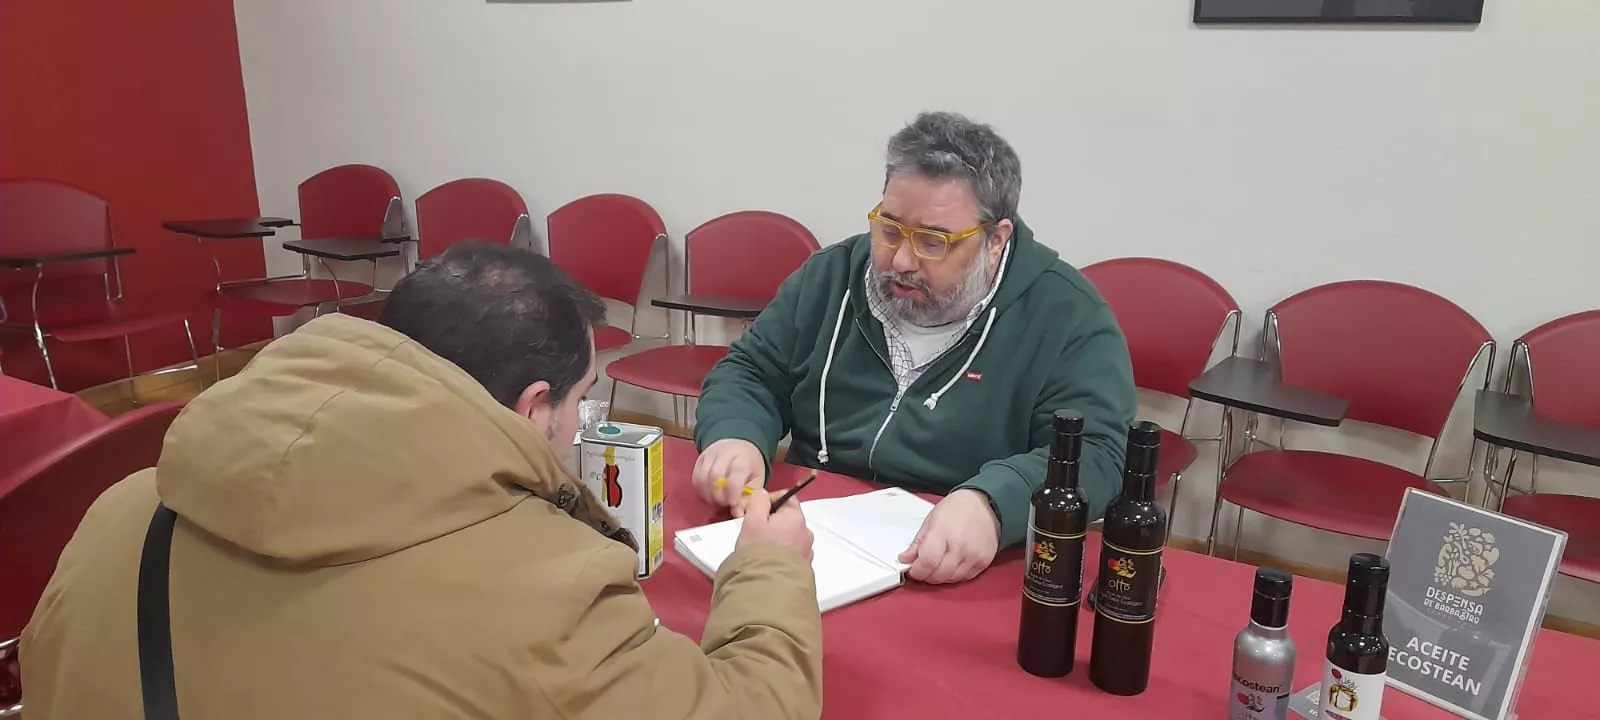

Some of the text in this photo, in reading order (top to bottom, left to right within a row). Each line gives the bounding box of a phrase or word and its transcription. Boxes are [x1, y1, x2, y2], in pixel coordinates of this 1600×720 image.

[1423, 598, 1434, 608] DE
[1434, 602, 1480, 625] BARBASTRO
[1426, 586, 1484, 616] DESPENSA
[1406, 636, 1471, 671] ACEITE
[1388, 647, 1482, 696] ECOSTEAN
